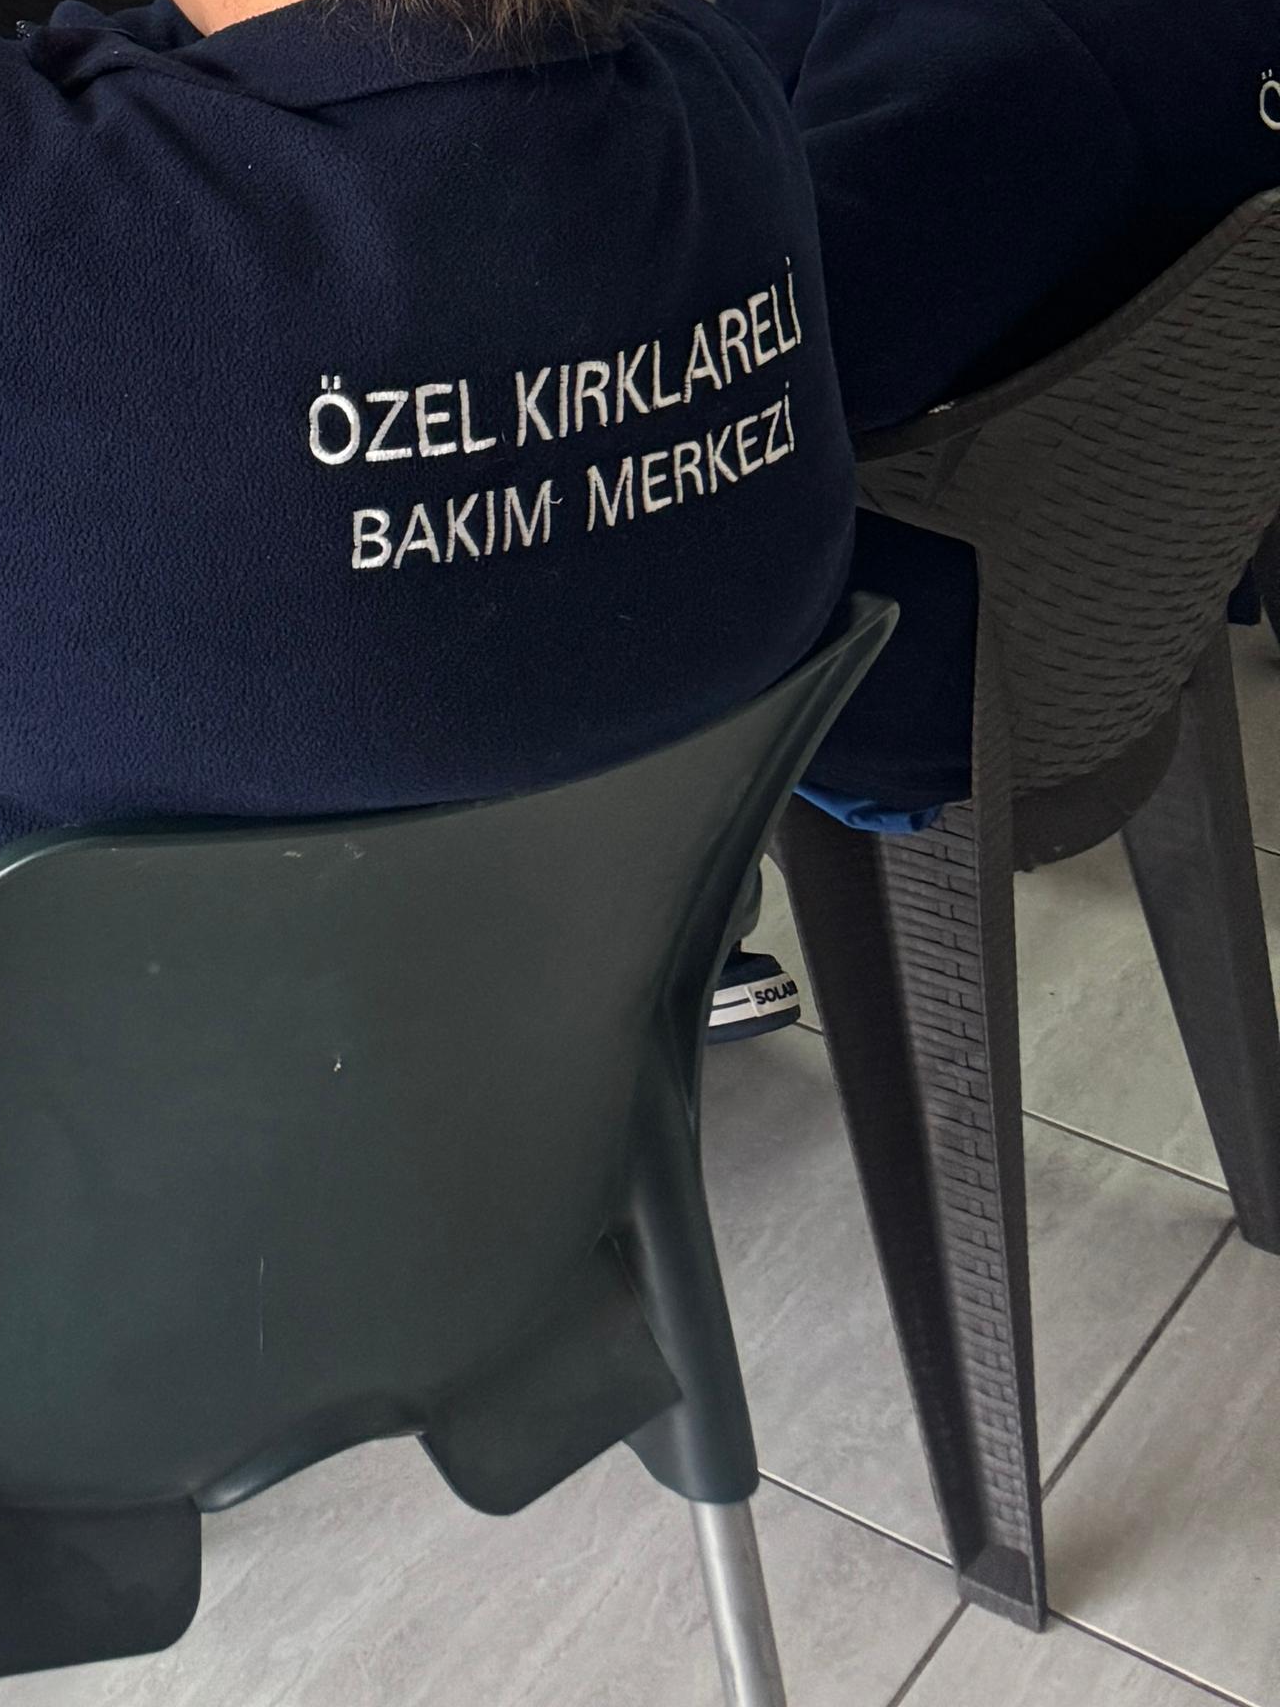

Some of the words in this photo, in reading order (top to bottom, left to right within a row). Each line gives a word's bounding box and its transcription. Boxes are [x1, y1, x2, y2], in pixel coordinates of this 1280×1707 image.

[307, 374, 498, 466] ÖZEL
[516, 256, 802, 450] KIRKLARELİ
[351, 479, 558, 572] BAKIM
[586, 380, 796, 532] MERKEZİ
